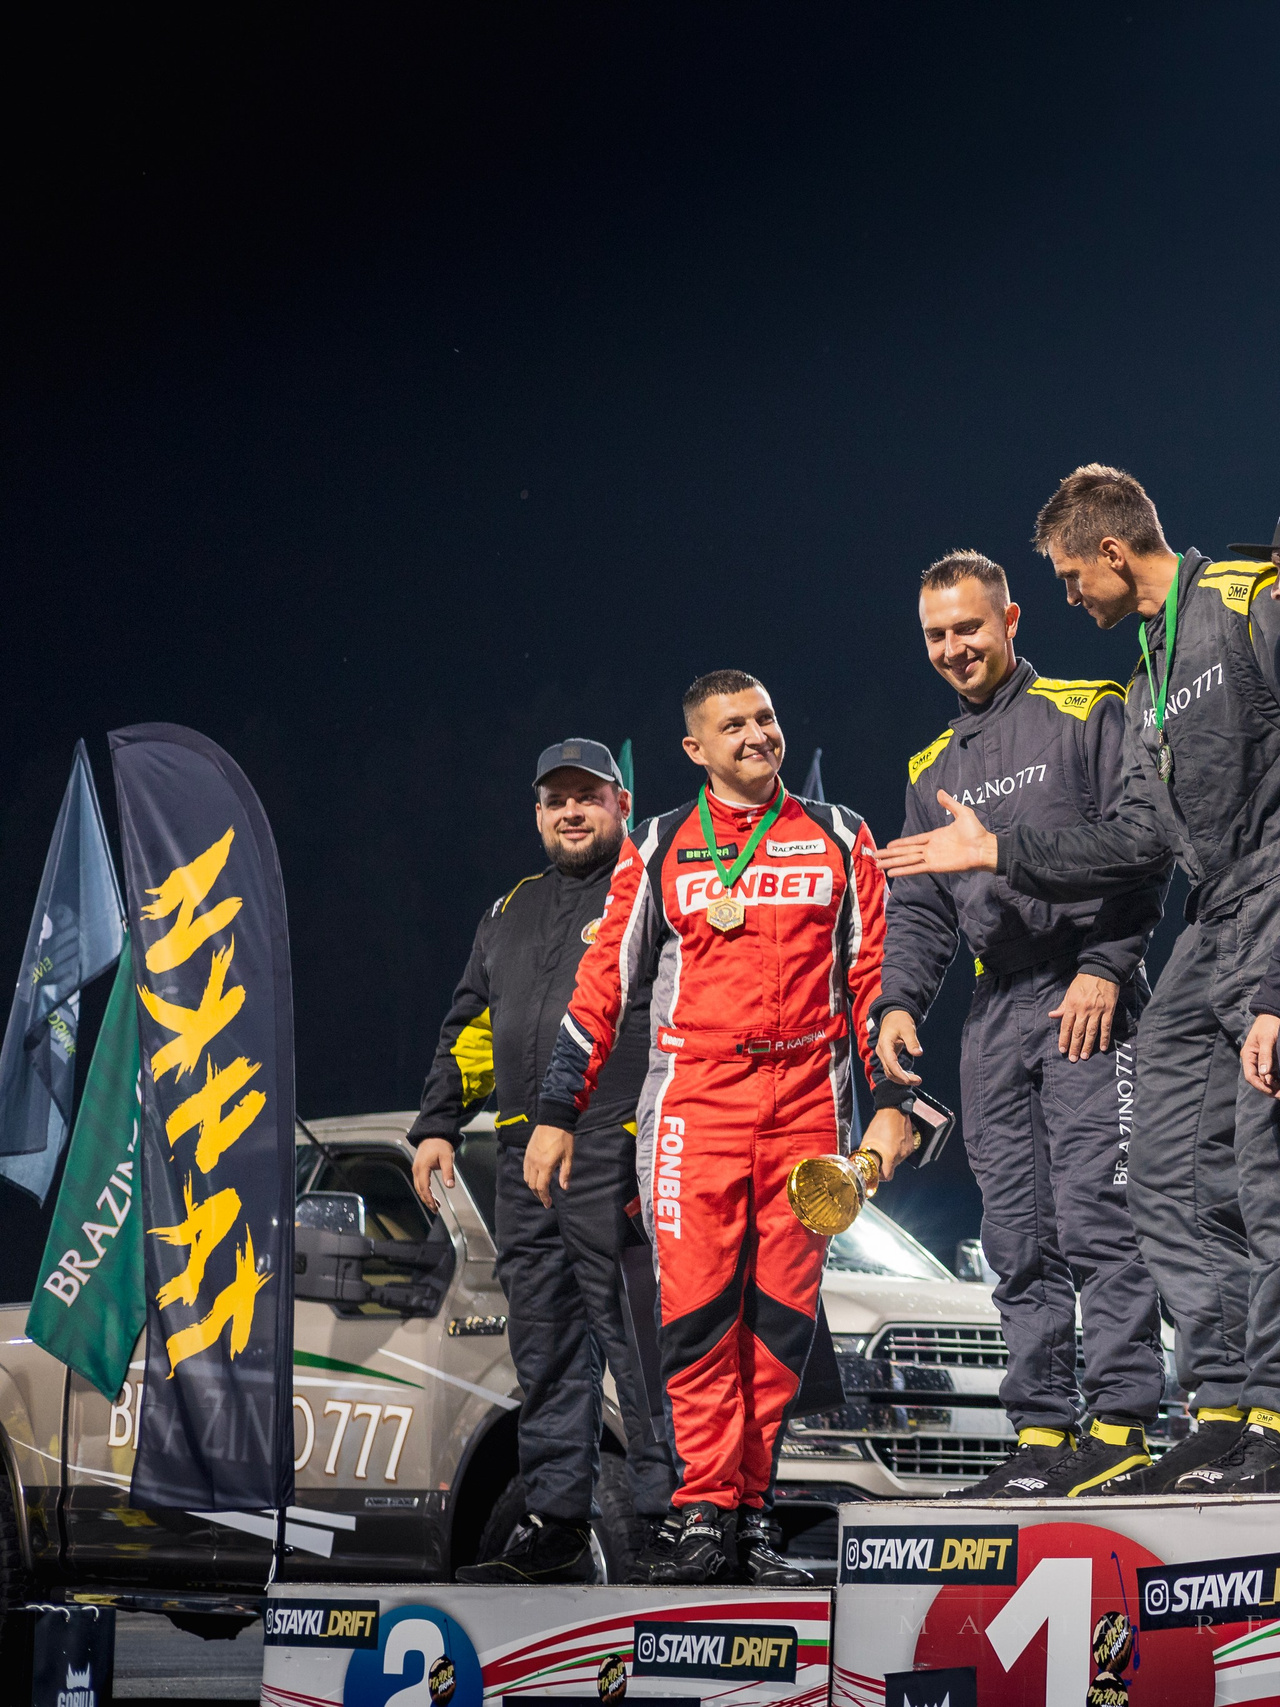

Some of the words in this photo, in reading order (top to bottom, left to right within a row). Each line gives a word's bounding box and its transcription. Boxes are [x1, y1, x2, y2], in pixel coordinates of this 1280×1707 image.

[1228, 585, 1249, 598] OMP
[1192, 663, 1224, 699] 777
[1064, 696, 1088, 706] OMP
[912, 751, 932, 771] OMP
[1016, 764, 1047, 789] 777
[686, 848, 729, 859] BETRA
[686, 872, 824, 907] FONBET
[657, 1115, 686, 1240] FONBET
[323, 1399, 415, 1482] 777
[859, 1538, 1012, 1571] STAYKI_DRIFT
[273, 1608, 376, 1638] STAYKI_DRIFT
[985, 1558, 1092, 1707] 1
[383, 1618, 446, 1707] 2
[656, 1634, 793, 1668] STAYKI_DRIFT
